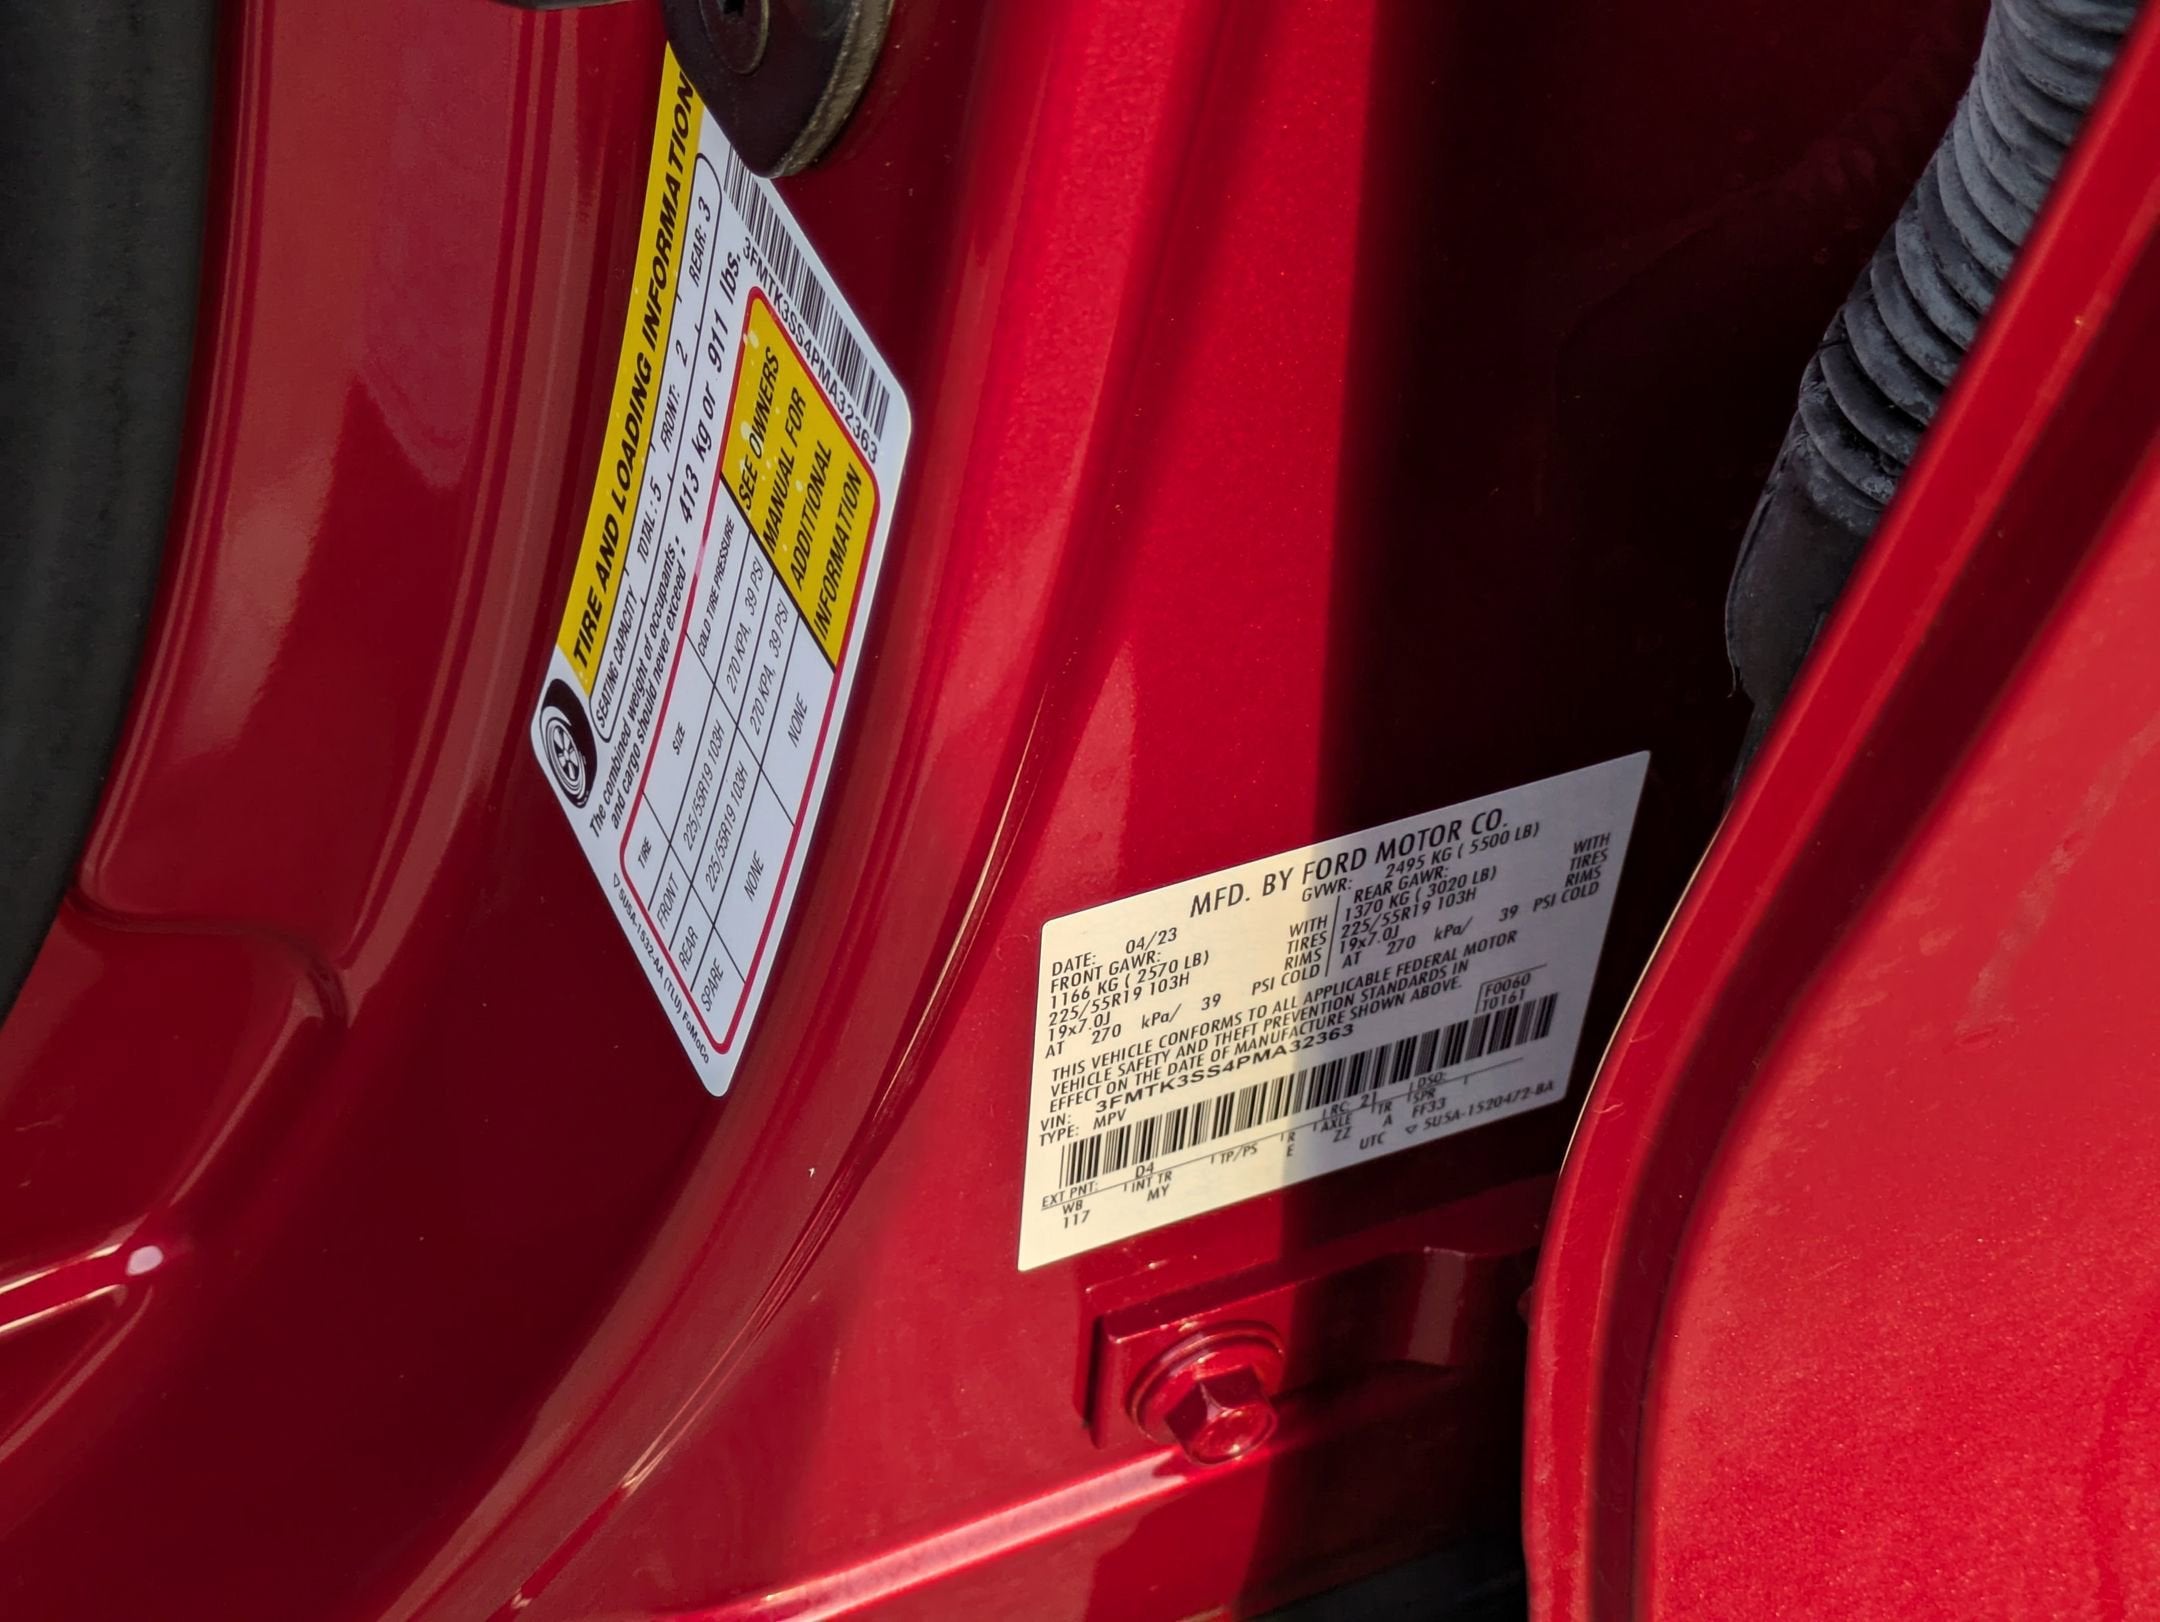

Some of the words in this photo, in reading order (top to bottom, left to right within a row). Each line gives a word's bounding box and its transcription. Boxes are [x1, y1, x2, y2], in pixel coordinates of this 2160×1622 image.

[697, 195, 711, 222] 3
[688, 224, 707, 288] REAR:
[719, 251, 741, 305] lbs.
[707, 308, 728, 373] 911
[742, 236, 878, 464] 3FMTK3SS4PMA32363
[573, 585, 603, 668] TIRE
[595, 513, 619, 593] AND
[611, 351, 652, 515] LOADING
[641, 71, 694, 352] INFORMATION
[660, 383, 680, 453] FRONT:
[675, 339, 688, 368] 2
[702, 380, 716, 420] or
[691, 418, 712, 463] kg
[738, 453, 758, 511] SEE
[748, 346, 779, 460] OWNERS
[649, 475, 662, 502] 5
[762, 446, 795, 554] MANUAL
[784, 386, 806, 448] FOR
[679, 463, 699, 524] 413
[790, 439, 832, 592] ADDITIONAL
[749, 555, 764, 592] PSI
[813, 462, 862, 641] INFORMATION
[697, 617, 711, 658] COLD
[705, 584, 719, 620] TIRE
[713, 514, 735, 591] PRESSURE
[744, 586, 757, 616] 39
[774, 597, 789, 634] PSI
[595, 660, 619, 729] SEATING
[613, 583, 637, 666] CAPACITY
[768, 628, 782, 659] 39
[589, 803, 606, 838] The
[602, 716, 632, 806] combined
[626, 656, 648, 723] weight
[643, 632, 653, 661] of
[649, 542, 679, 639] occupants
[611, 788, 626, 830] and
[621, 742, 641, 795] cargo
[636, 677, 657, 745] should
[652, 628, 670, 686] never
[665, 558, 686, 632] exceed
[726, 655, 741, 694] 270
[672, 721, 686, 756] SIZE
[749, 696, 765, 736] 270
[787, 691, 808, 748] NONE
[682, 762, 713, 851] 225/55R19
[707, 719, 725, 765] 103H
[705, 803, 736, 893] 225/55R19
[730, 760, 748, 807] 103H
[1573, 832, 1611, 855] WITH
[637, 836, 652, 869] TIRE
[743, 849, 764, 902] NONE
[1189, 882, 1250, 918] MFD.
[1262, 866, 1294, 897] BY
[1302, 847, 1367, 885] FORD
[1374, 819, 1462, 864] MOTOR
[1470, 807, 1508, 835] CO.
[1301, 877, 1353, 902] GVWR:
[1384, 853, 1426, 879] 2495
[1430, 846, 1452, 865] KG
[1468, 829, 1510, 854] 5500
[1514, 821, 1540, 841] LB)
[1569, 847, 1608, 872] TIRES
[1345, 898, 1384, 922] 1370
[1388, 890, 1410, 909] KG
[1426, 873, 1468, 898] 3020
[1471, 865, 1497, 885] LB)
[1353, 879, 1393, 904] REAR
[1397, 865, 1448, 891] GAWR:
[1564, 864, 1602, 888] RIMS
[656, 871, 679, 930] FRONT
[1340, 899, 1432, 939] 225/55R19
[1437, 886, 1477, 910] 103H
[1287, 929, 1327, 955] TIRES
[1289, 914, 1328, 938] WITH
[1339, 924, 1400, 954] 19x7.0J
[1341, 950, 1362, 969] AT
[1385, 934, 1416, 956] 270
[1433, 916, 1473, 942] kPa/
[1498, 904, 1519, 922] 39
[1532, 892, 1557, 912] PSI
[1560, 880, 1600, 904] COLD
[678, 925, 699, 971] REAR
[1051, 951, 1096, 977] DATE:
[1125, 926, 1177, 954] 04/23
[1283, 946, 1322, 971] RIMS
[700, 957, 724, 1012] SPARE
[1050, 964, 1103, 994] FRONT
[1108, 949, 1161, 976] GAWR:
[1051, 985, 1090, 1009] 1166
[1097, 976, 1118, 996] KG
[1136, 959, 1179, 984] 2570
[1183, 949, 1209, 970] LB)
[663, 976, 682, 1014] (TLU)
[681, 1010, 709, 1064] FoMoCo
[1044, 1039, 1065, 1059] AT
[1091, 1023, 1122, 1045] 270
[1140, 1003, 1182, 1030] kPa/
[1200, 992, 1222, 1011] 39
[1251, 976, 1275, 996] PSI
[1280, 963, 1320, 986] COLD
[1048, 985, 1142, 1027] 225/55R19
[1150, 971, 1190, 996] 103H
[1052, 1059, 1085, 1082] THIS
[1091, 1038, 1153, 1069] VEHICLE
[1158, 1011, 1242, 1049] CONFORMS
[1248, 1004, 1268, 1022] TO
[1271, 995, 1298, 1015] ALL
[1302, 966, 1391, 1005] APPLICABLE
[1395, 947, 1457, 978] FEDERAL
[1462, 929, 1518, 957] MOTOR
[1049, 1010, 1111, 1042] 19x7.0J
[1049, 1084, 1101, 1113] EFFECT
[1105, 1076, 1128, 1095] ON
[1135, 1066, 1161, 1086] THE
[1167, 1052, 1204, 1077] DATE
[1210, 1045, 1230, 1063] OF
[1233, 1009, 1346, 1056] MANUFACTURE
[1349, 991, 1406, 1021] SHOWN
[1409, 975, 1462, 1002] ABOVE.
[1050, 1066, 1112, 1097] VEHICLE
[1117, 1048, 1171, 1077] SAFETY
[1175, 1037, 1209, 1059] AND
[1214, 1021, 1258, 1047] THEFT
[1263, 992, 1355, 1032] PREVENTION
[1360, 964, 1447, 1003] STANDARDS
[1451, 958, 1469, 975] IN
[1040, 1112, 1071, 1132] VIN:
[1095, 1023, 1354, 1113] 3FMTK3SS4PMA32363
[1039, 1124, 1079, 1147] TYPE:
[1092, 1107, 1127, 1130] MPV
[1320, 1112, 1353, 1132] AXLE
[1382, 1113, 1393, 1127] A
[1411, 1096, 1447, 1118] FF33
[1219, 1141, 1259, 1164] TP/PS
[1286, 1143, 1294, 1157] E
[1332, 1125, 1352, 1143] ZZ
[1358, 1131, 1385, 1150] UTC
[1041, 1190, 1065, 1209] EXT
[1131, 1174, 1153, 1193] INT
[1157, 1169, 1172, 1184] TR
[1146, 1183, 1170, 1202] MY
[1062, 1199, 1083, 1215] WB
[1063, 1208, 1090, 1229] 117
